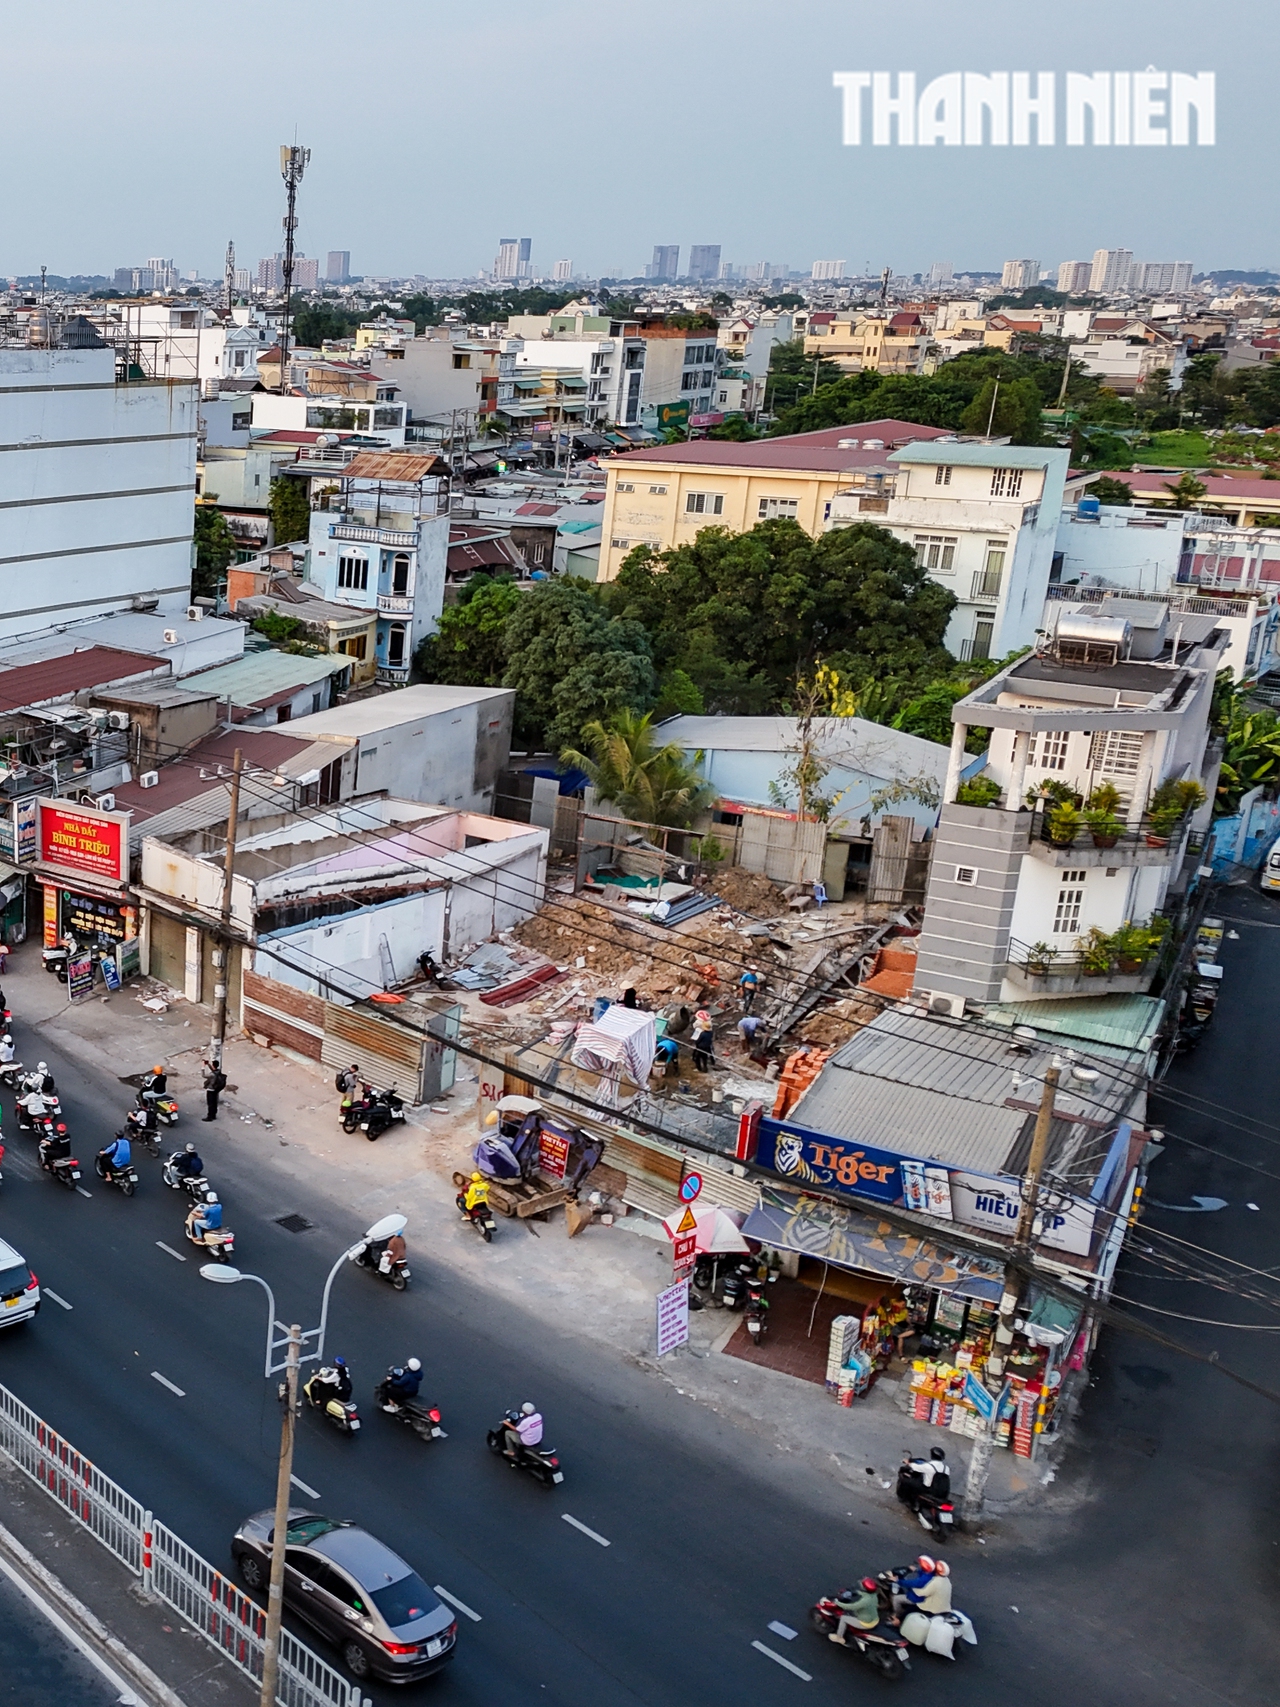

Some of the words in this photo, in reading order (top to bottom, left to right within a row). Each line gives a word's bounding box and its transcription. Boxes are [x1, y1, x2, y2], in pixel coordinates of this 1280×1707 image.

[51, 829, 77, 848] BÌNH
[78, 840, 111, 856] TRIỆU
[63, 822, 81, 834] NHÀ
[81, 824, 97, 838] ĐẤT
[808, 1141, 896, 1186] Tiger
